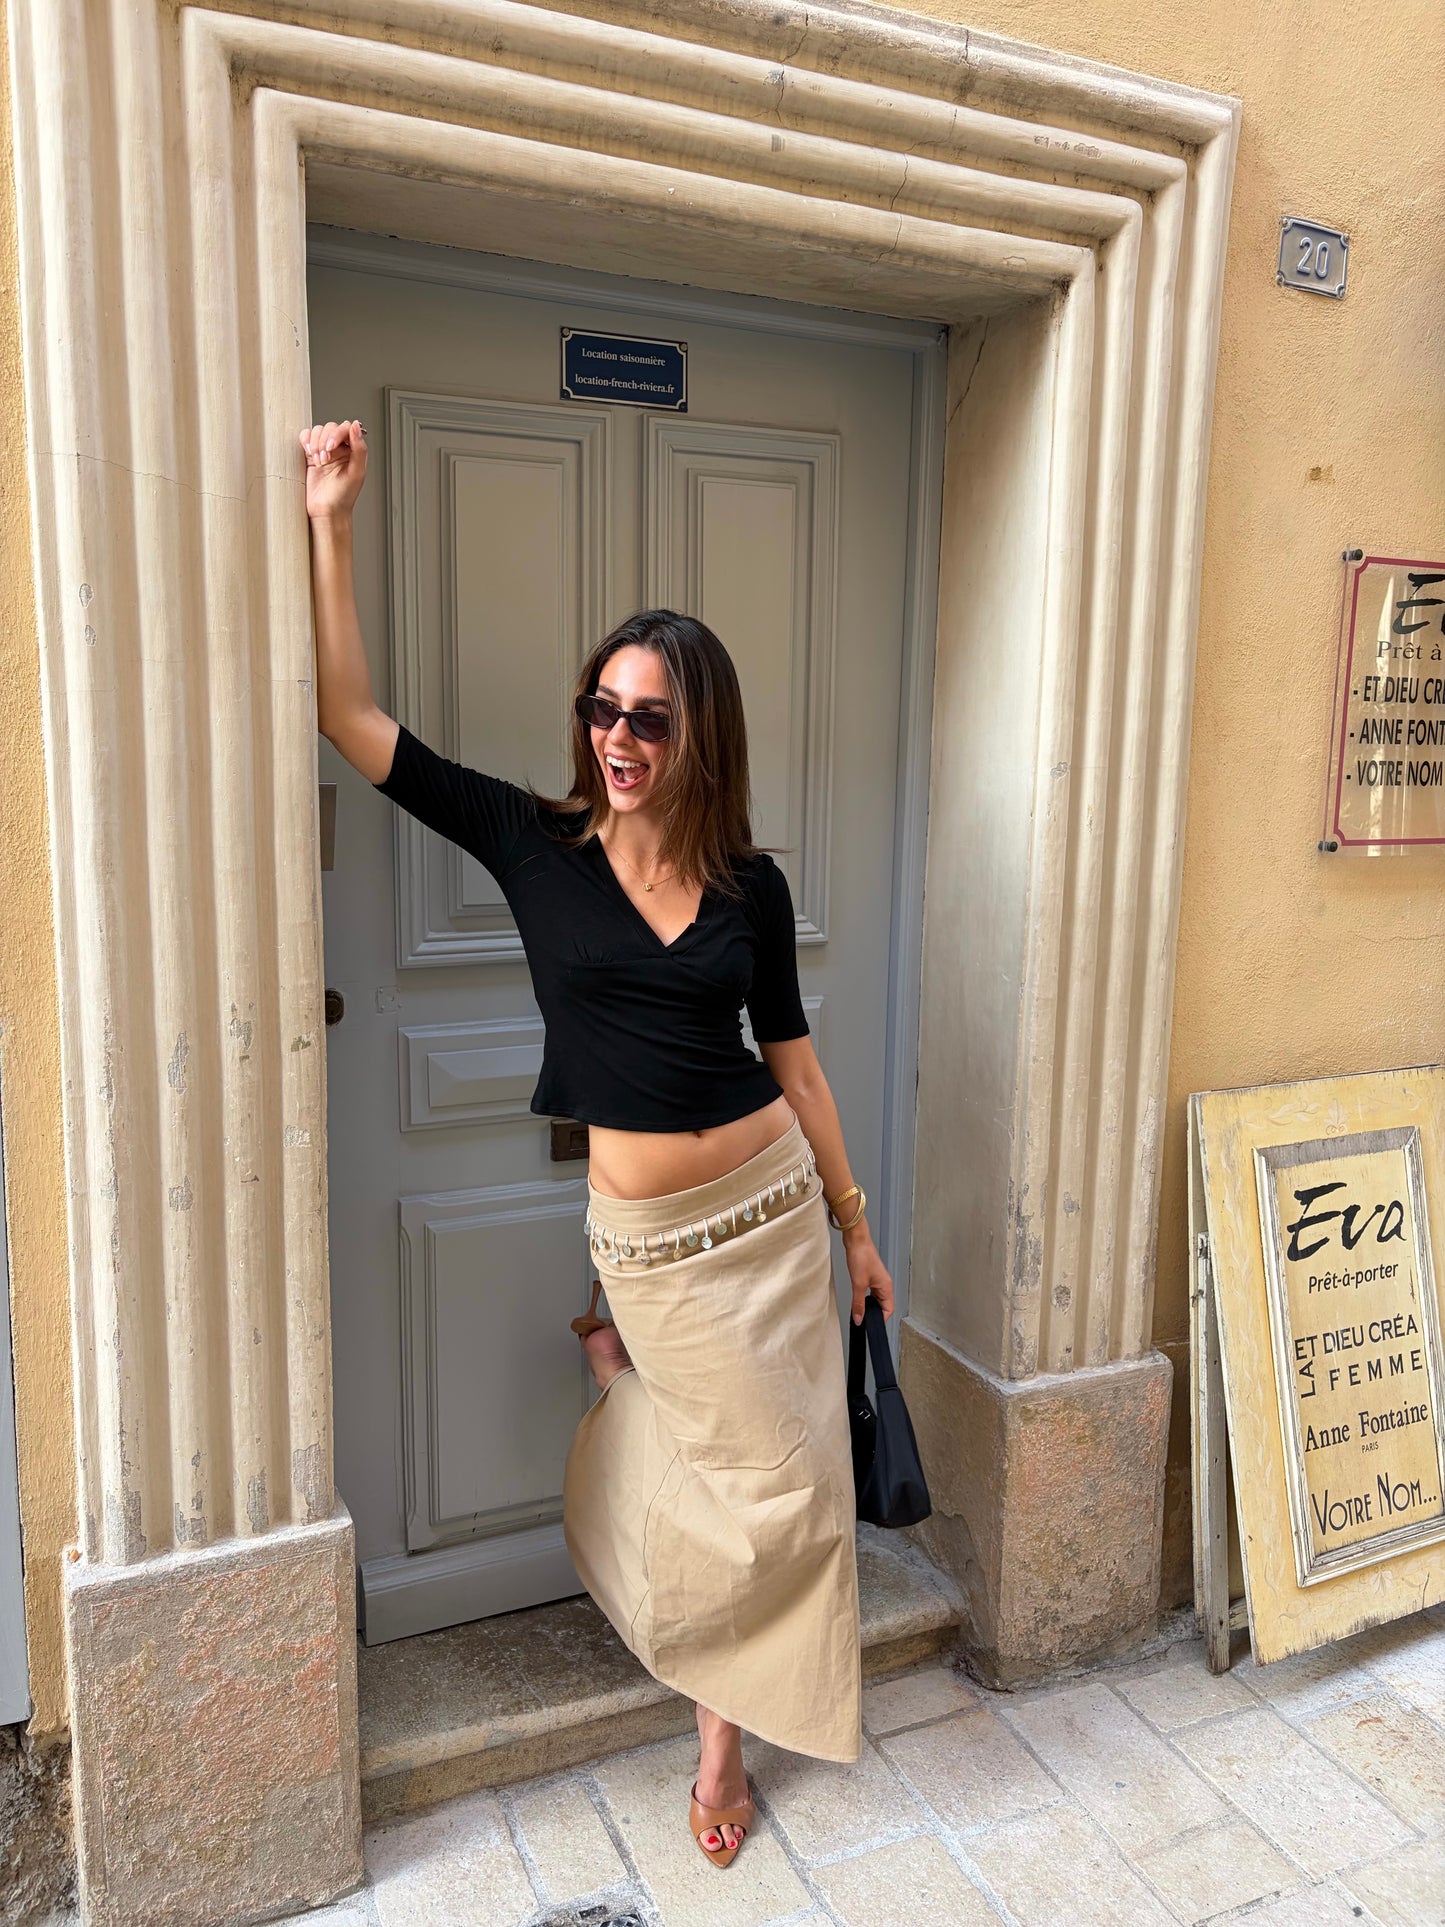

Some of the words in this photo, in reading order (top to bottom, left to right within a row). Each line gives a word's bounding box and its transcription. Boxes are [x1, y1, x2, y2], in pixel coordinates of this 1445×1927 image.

[1297, 236, 1330, 279] 20
[581, 347, 618, 361] Location
[619, 353, 667, 367] saisonnière
[575, 373, 675, 394] location-french-riviera.fr
[1392, 572, 1445, 635] E
[1376, 640, 1424, 660] Prêt
[1430, 643, 1442, 661] à
[1363, 675, 1381, 702] ET
[1384, 676, 1420, 703] DIEU
[1359, 718, 1403, 745] ANNE
[1407, 719, 1445, 746] FONT
[1357, 760, 1403, 787] VOTRE
[1407, 760, 1443, 787] NOM
[1287, 1181, 1407, 1262] Eva
[1308, 1263, 1399, 1294] Prêt-à-porter
[1294, 1334, 1318, 1360] ET
[1322, 1325, 1364, 1354] DIEU
[1368, 1313, 1418, 1343] CRÉA
[1299, 1360, 1316, 1399] LA
[1329, 1348, 1422, 1392] FEMME
[1305, 1424, 1351, 1452] Anne
[1358, 1401, 1428, 1438] Fontaine
[1361, 1441, 1379, 1454] PARIS
